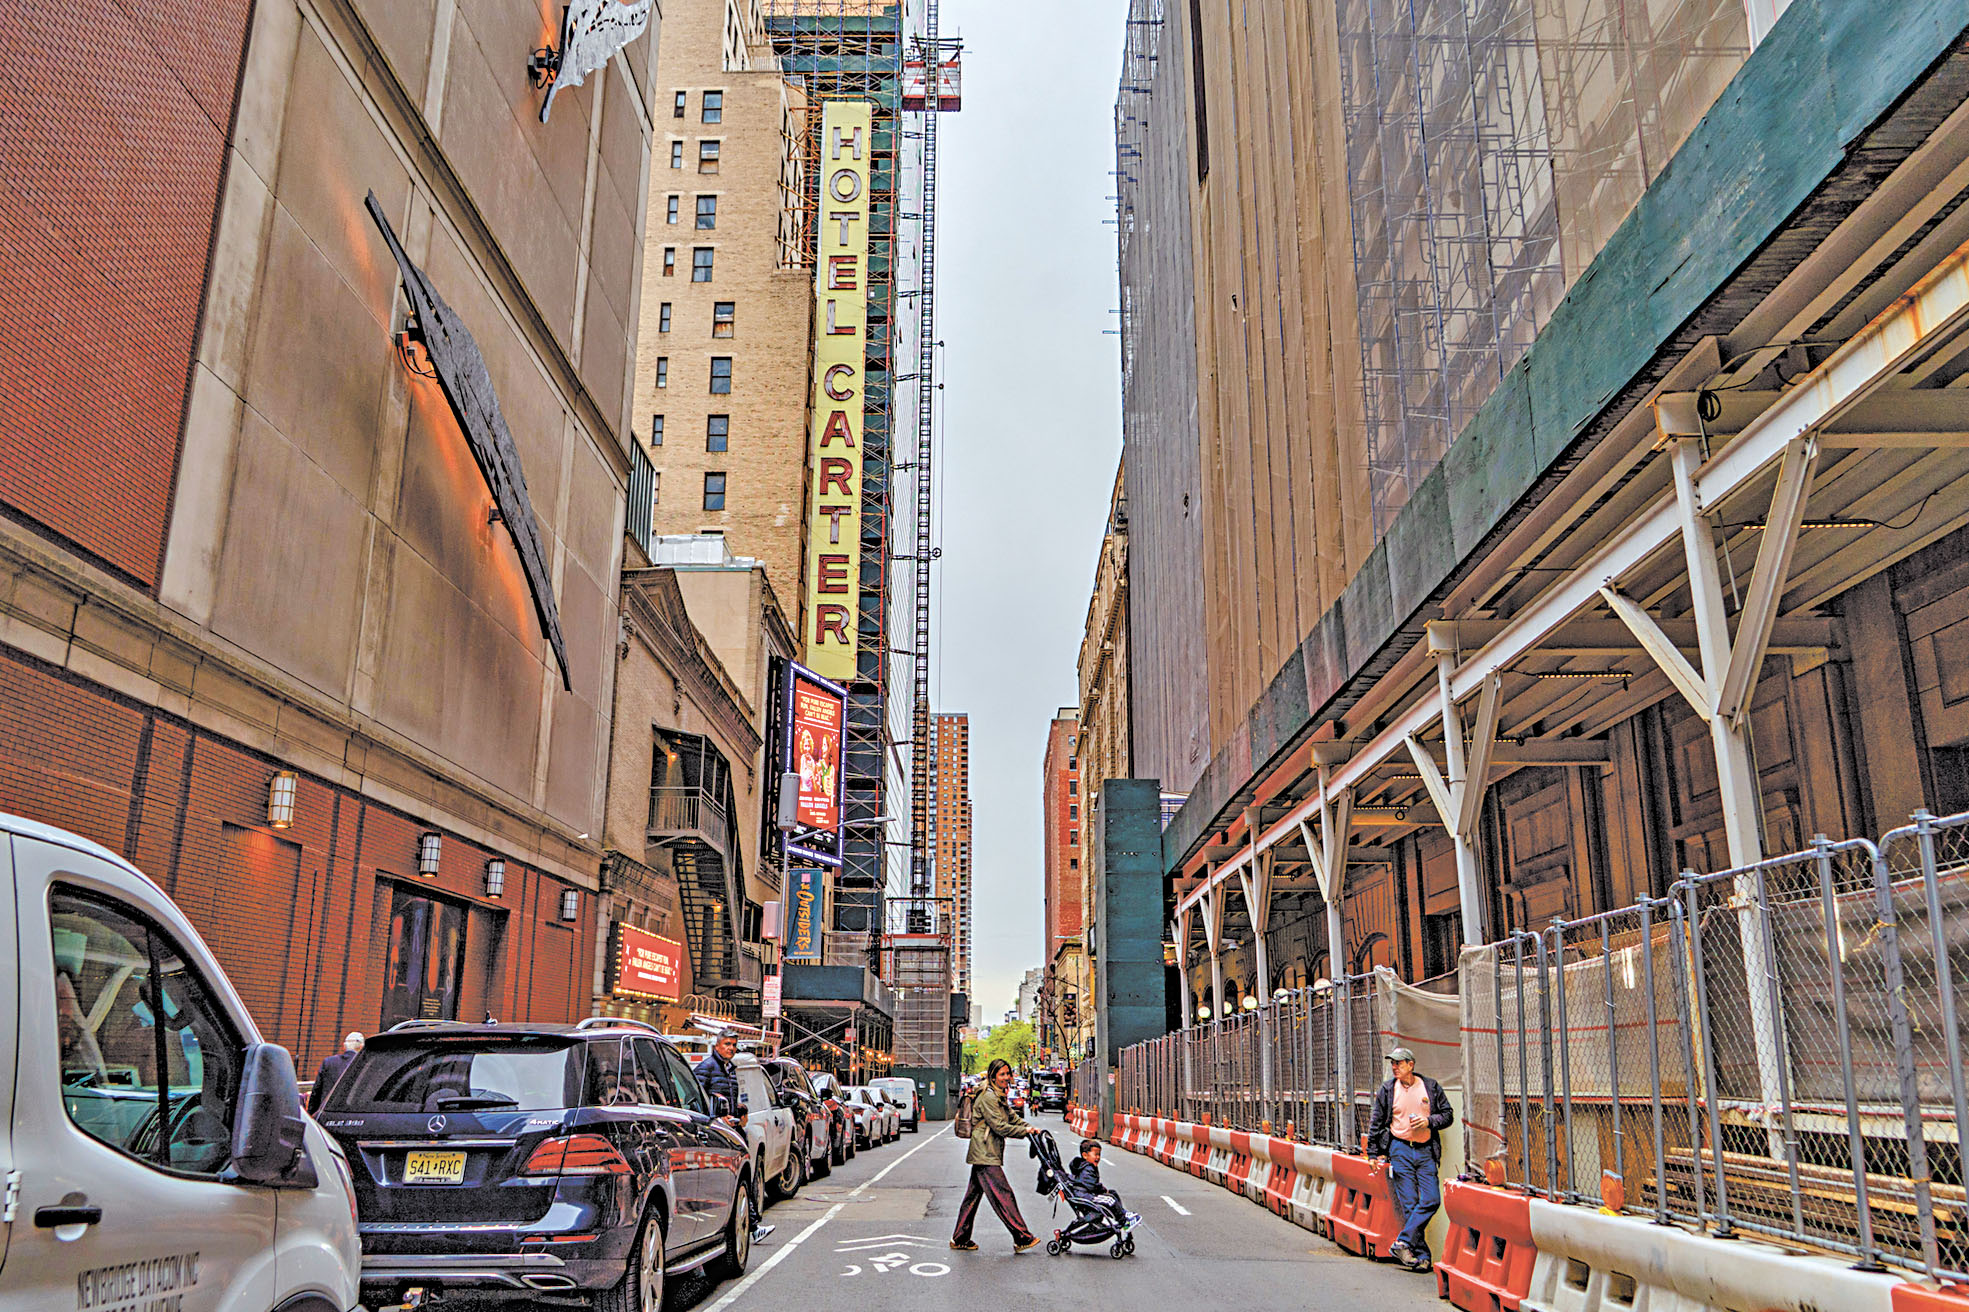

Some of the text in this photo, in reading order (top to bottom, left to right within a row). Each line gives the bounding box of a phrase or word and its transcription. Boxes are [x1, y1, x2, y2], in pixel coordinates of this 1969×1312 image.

[826, 126, 862, 336] HOTEL
[815, 363, 855, 645] CARTER
[77, 1262, 138, 1310] NEWBRIDGE
[138, 1254, 184, 1298] DATACOM
[183, 1251, 200, 1288] INC
